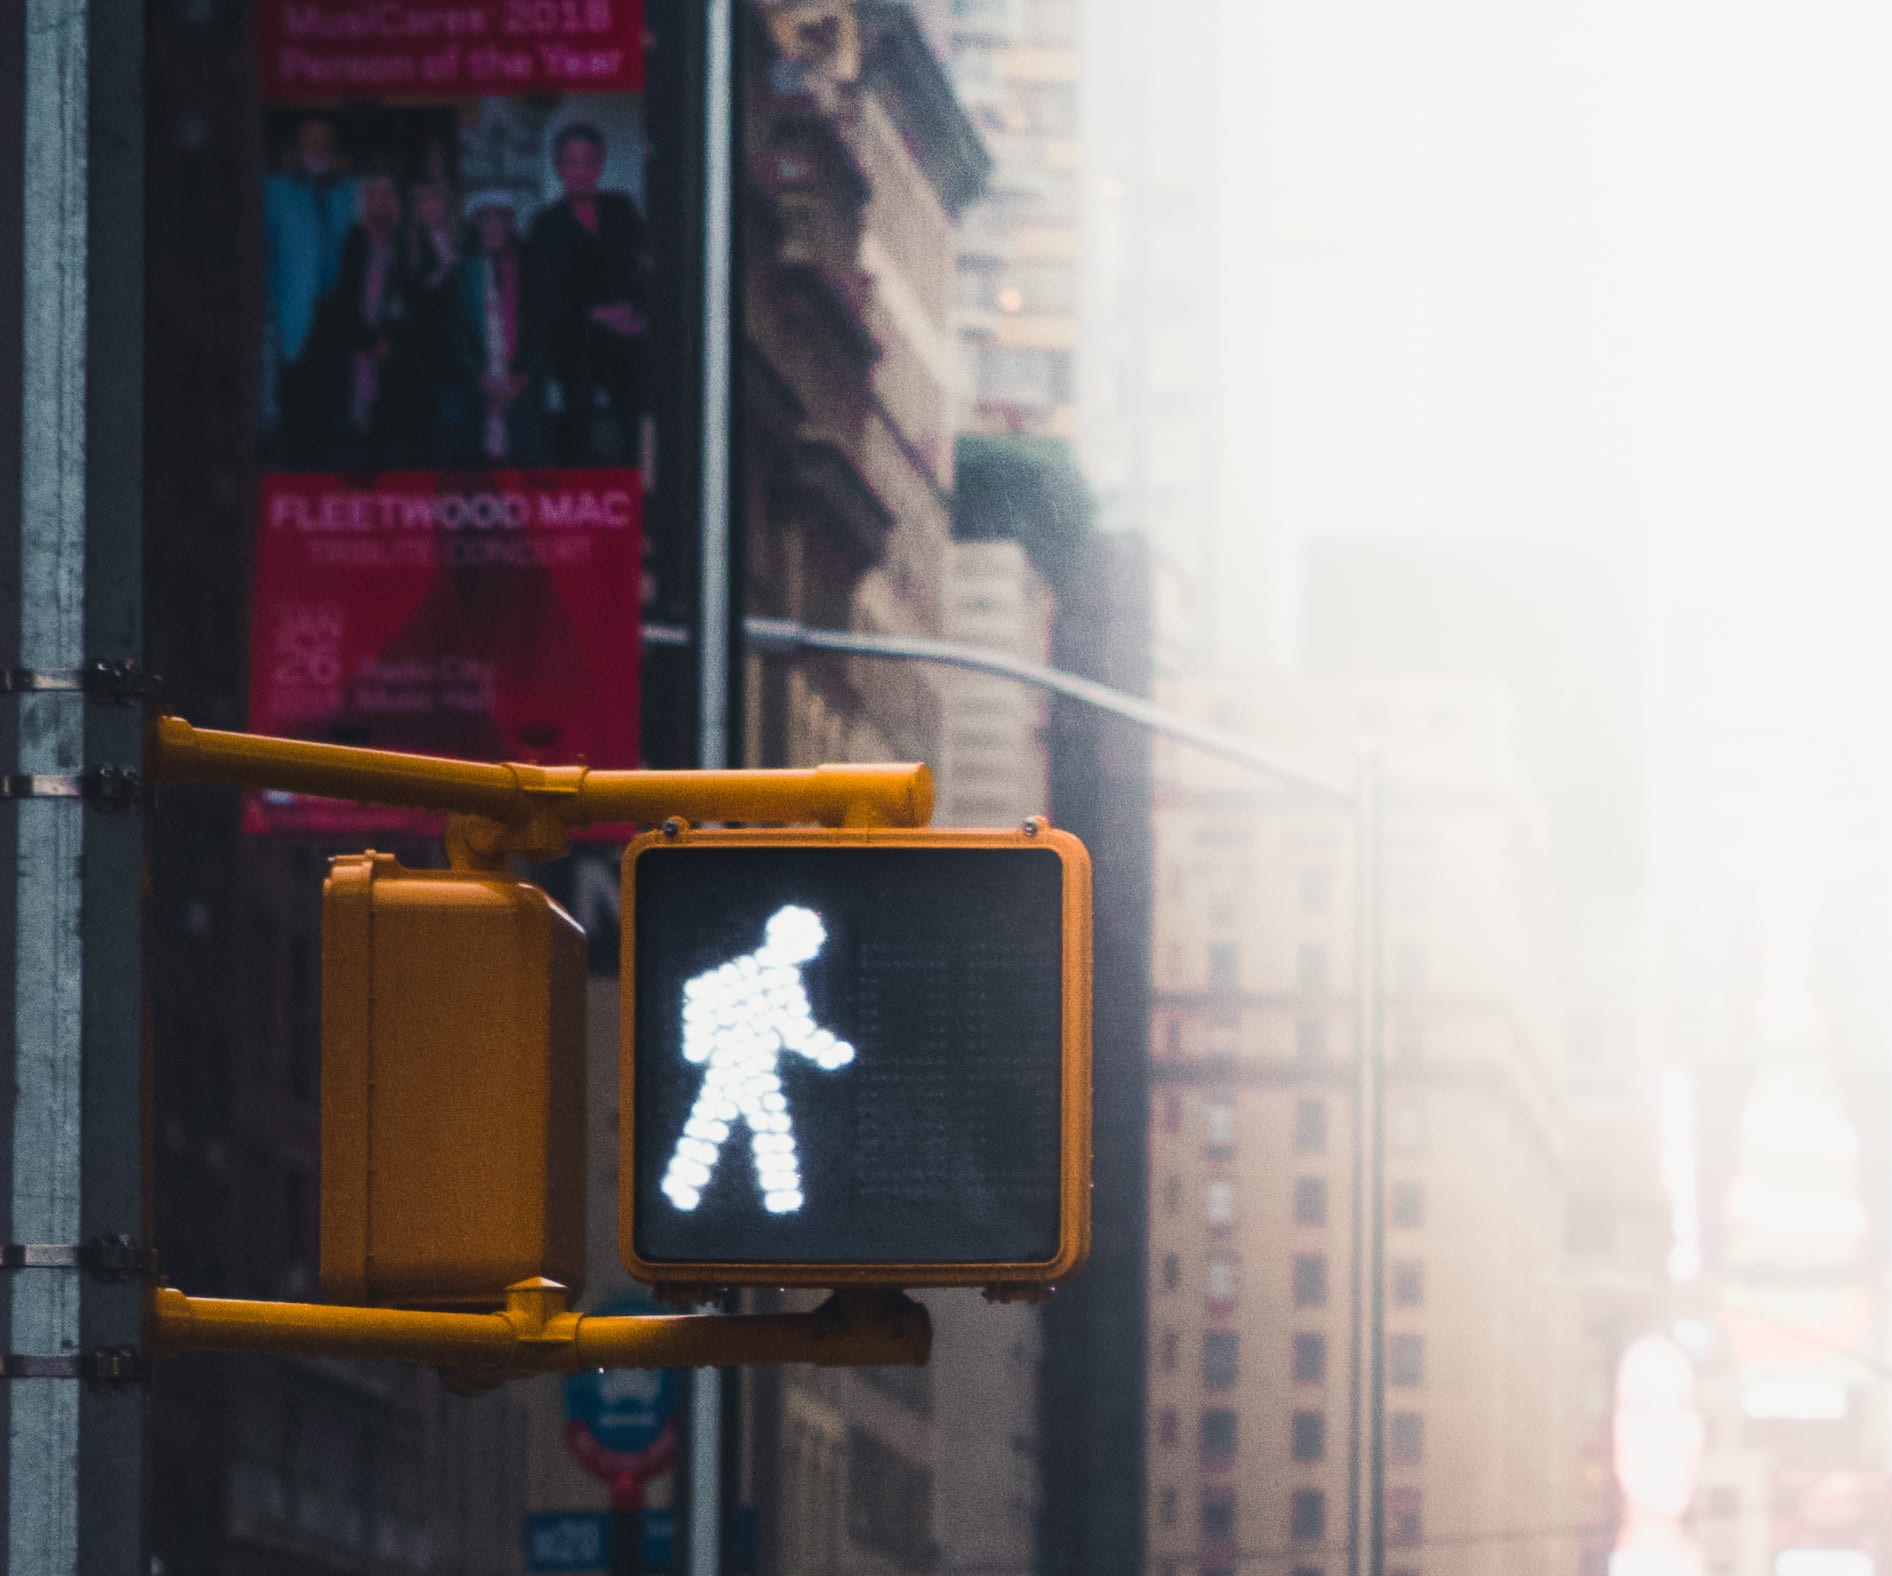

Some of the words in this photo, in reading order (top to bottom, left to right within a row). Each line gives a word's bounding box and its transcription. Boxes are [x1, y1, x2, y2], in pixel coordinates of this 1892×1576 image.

[279, 47, 414, 81] Person
[422, 45, 459, 81] of
[468, 46, 532, 80] the
[539, 45, 623, 78] Year
[271, 494, 530, 530] FLEETWOOD
[538, 492, 631, 528] MAC
